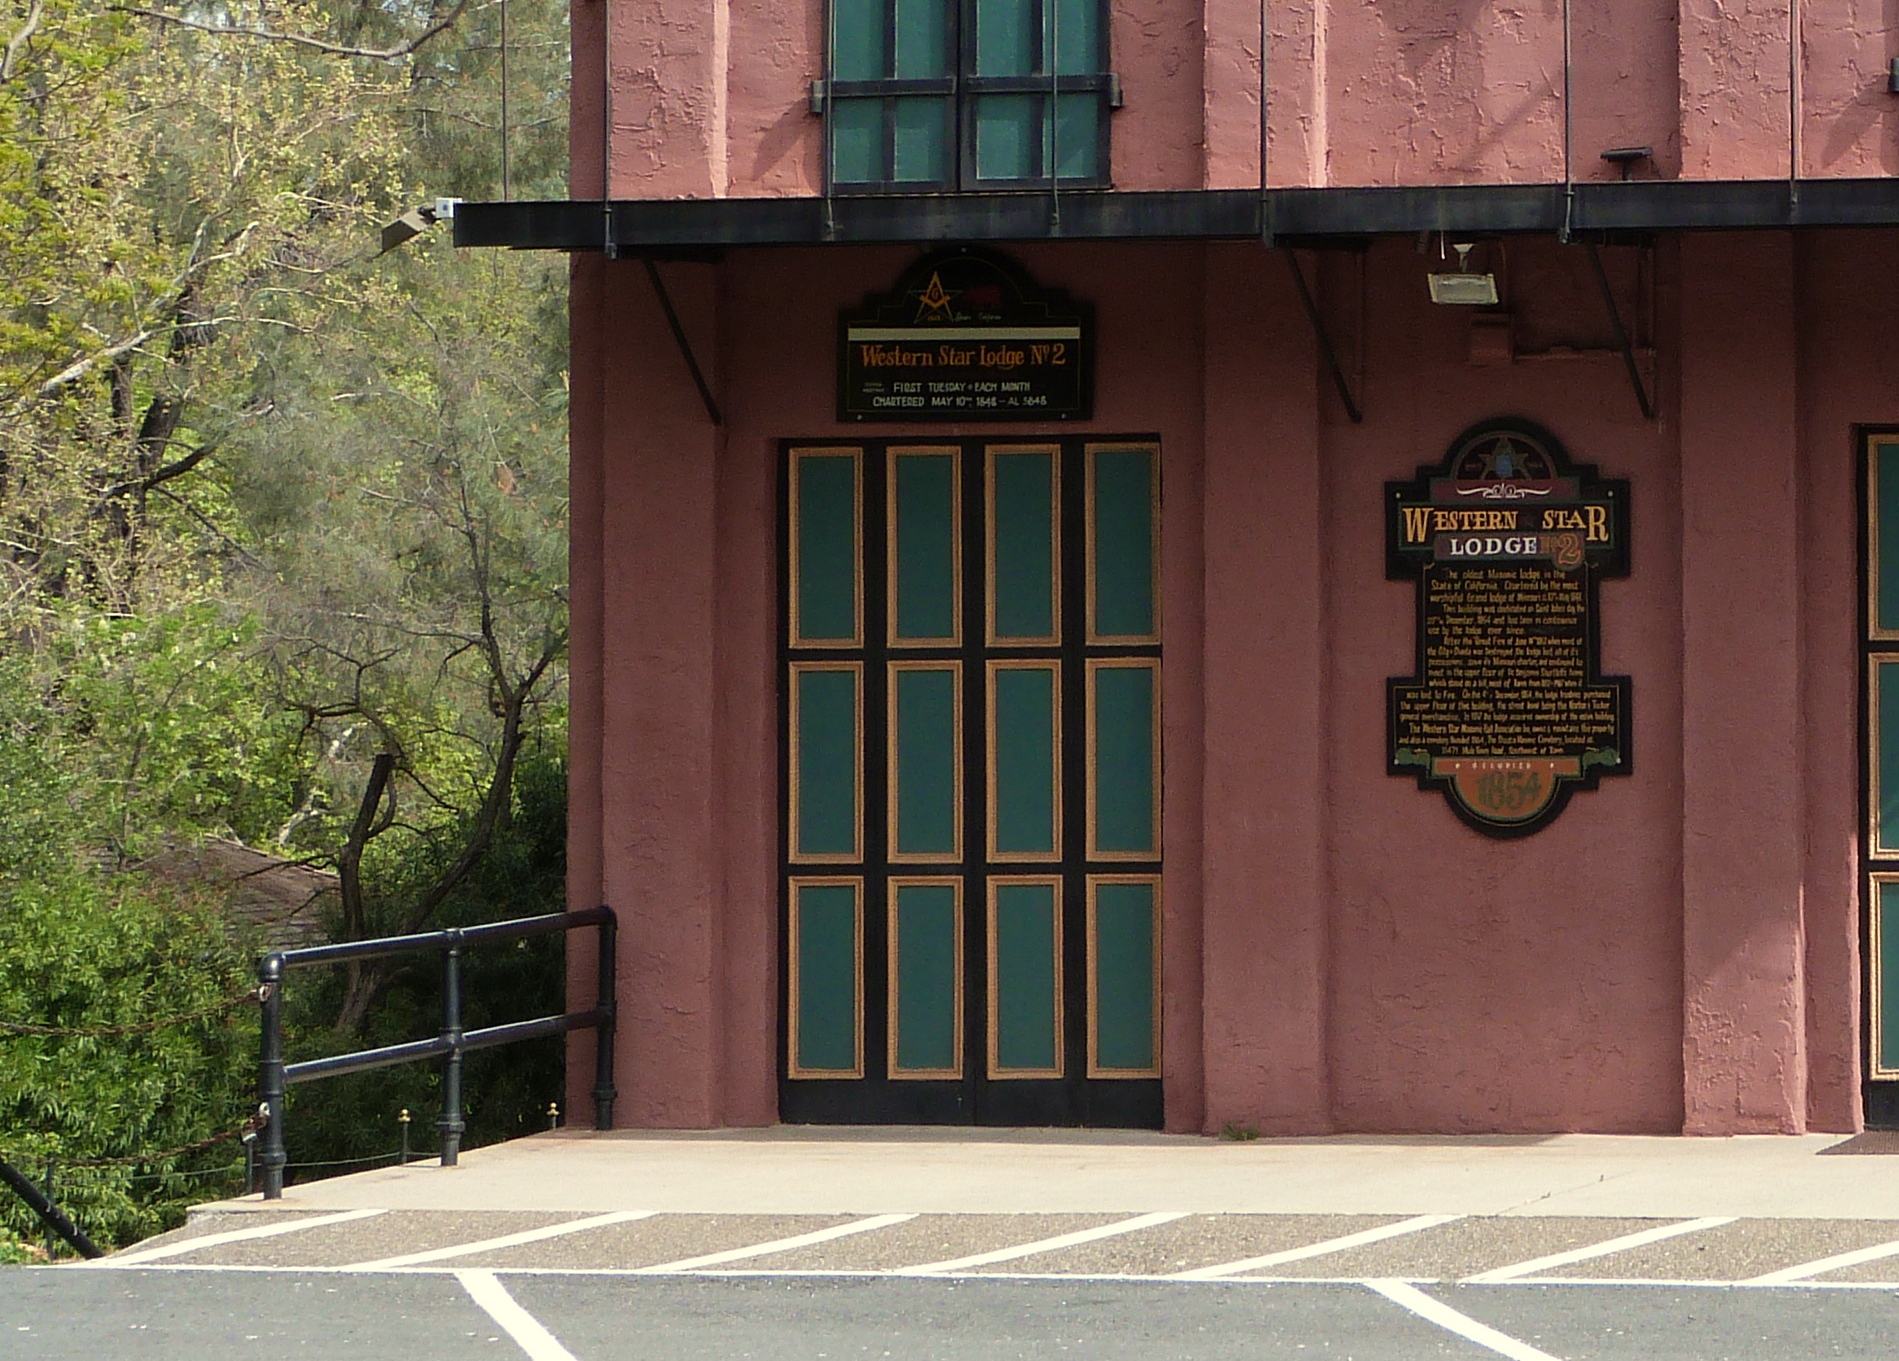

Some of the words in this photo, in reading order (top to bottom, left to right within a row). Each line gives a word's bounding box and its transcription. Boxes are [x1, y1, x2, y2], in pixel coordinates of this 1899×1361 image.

[861, 344, 934, 367] Western
[938, 344, 976, 367] Star
[979, 344, 1025, 370] Lodge
[1052, 342, 1066, 365] 2
[873, 396, 925, 407] CHARTERED
[931, 396, 954, 407] MAY
[893, 382, 923, 393] FIRST
[928, 382, 966, 393] TUESDAY
[975, 382, 998, 393] EACH
[1001, 382, 1031, 393] MONTH
[1402, 507, 1519, 543] WESTERN
[1542, 505, 1609, 542] STAR
[1451, 537, 1537, 556] LODGE
[1558, 533, 1581, 565] 2
[1477, 771, 1542, 810] 1854
